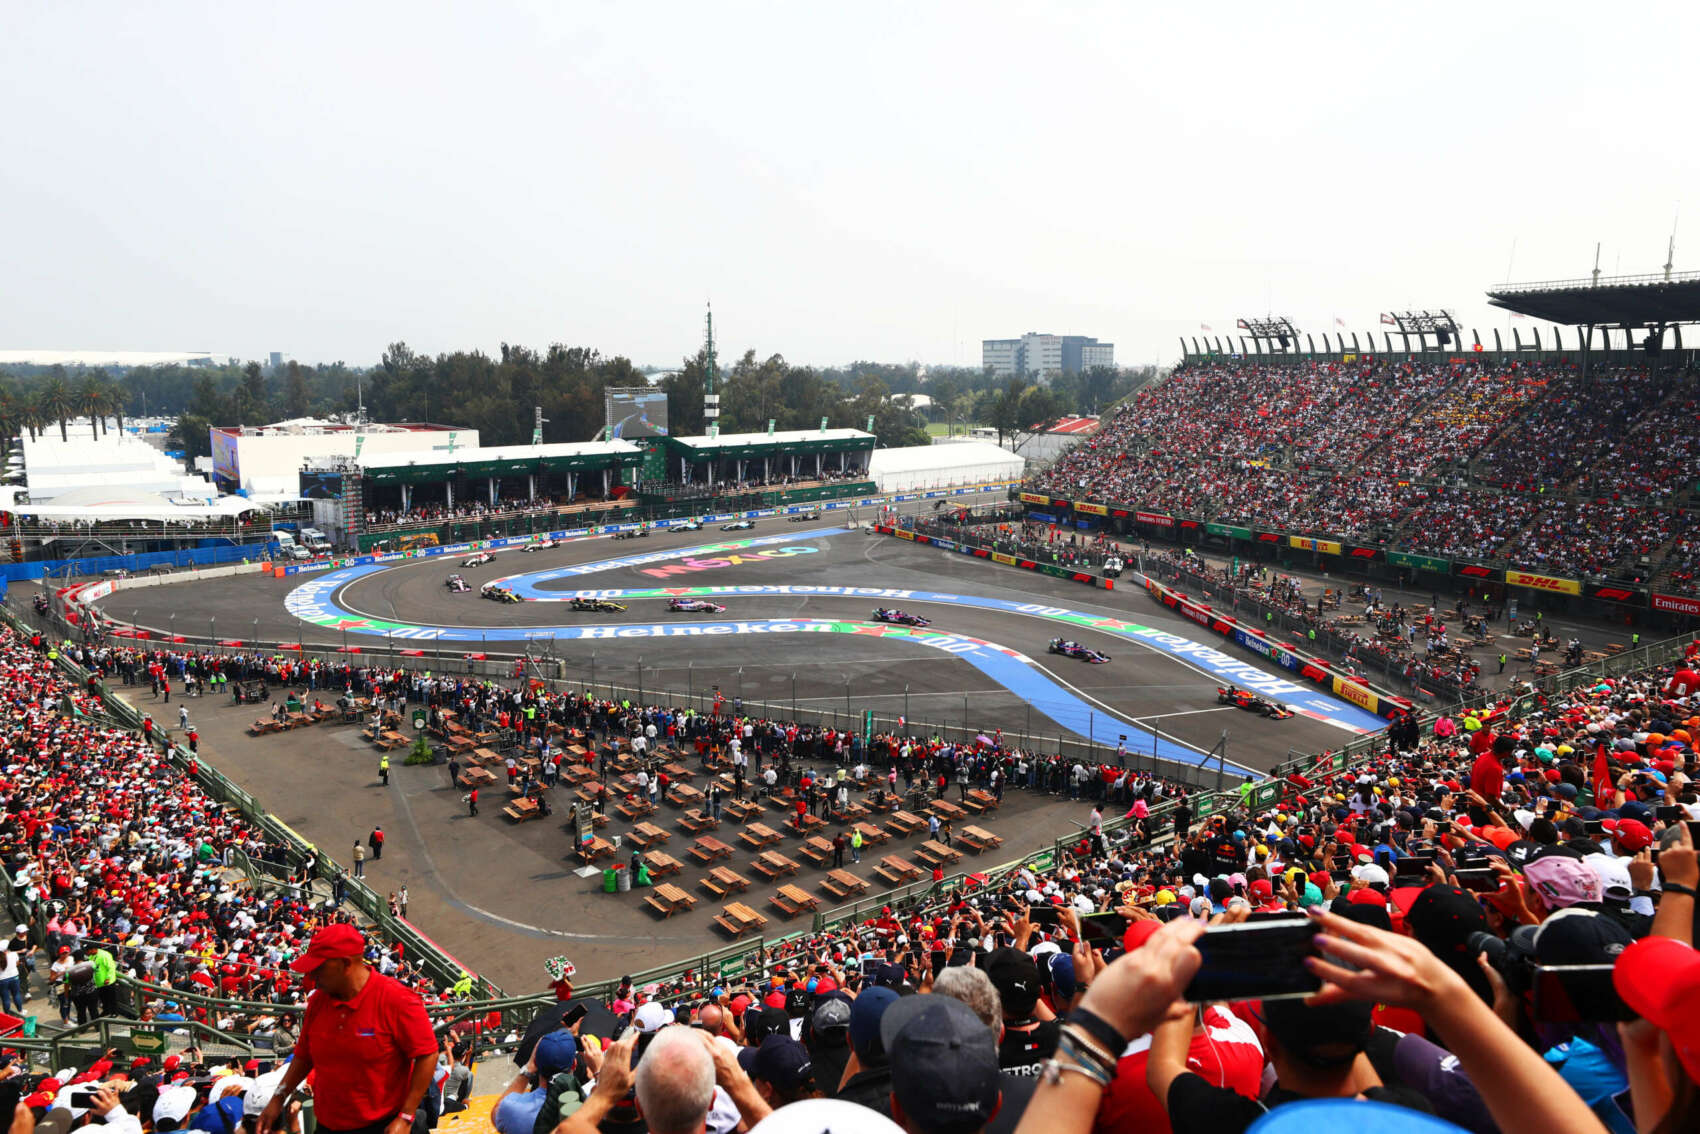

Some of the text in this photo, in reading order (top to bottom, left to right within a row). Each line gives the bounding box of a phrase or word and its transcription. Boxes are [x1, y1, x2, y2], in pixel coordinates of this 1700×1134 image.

[1079, 505, 1099, 513] DHL
[507, 535, 532, 544] Heineken
[444, 543, 471, 553] Heineken
[375, 553, 404, 563] Heineken
[298, 561, 331, 573] Heineken
[1518, 574, 1560, 590] DHL
[710, 585, 917, 598] Heineken
[1655, 598, 1699, 613] Emirates
[576, 622, 834, 639] Heineken
[1245, 636, 1270, 656] Heineken
[1134, 628, 1312, 695] Heineken
[1341, 683, 1369, 706] PIRELLI
